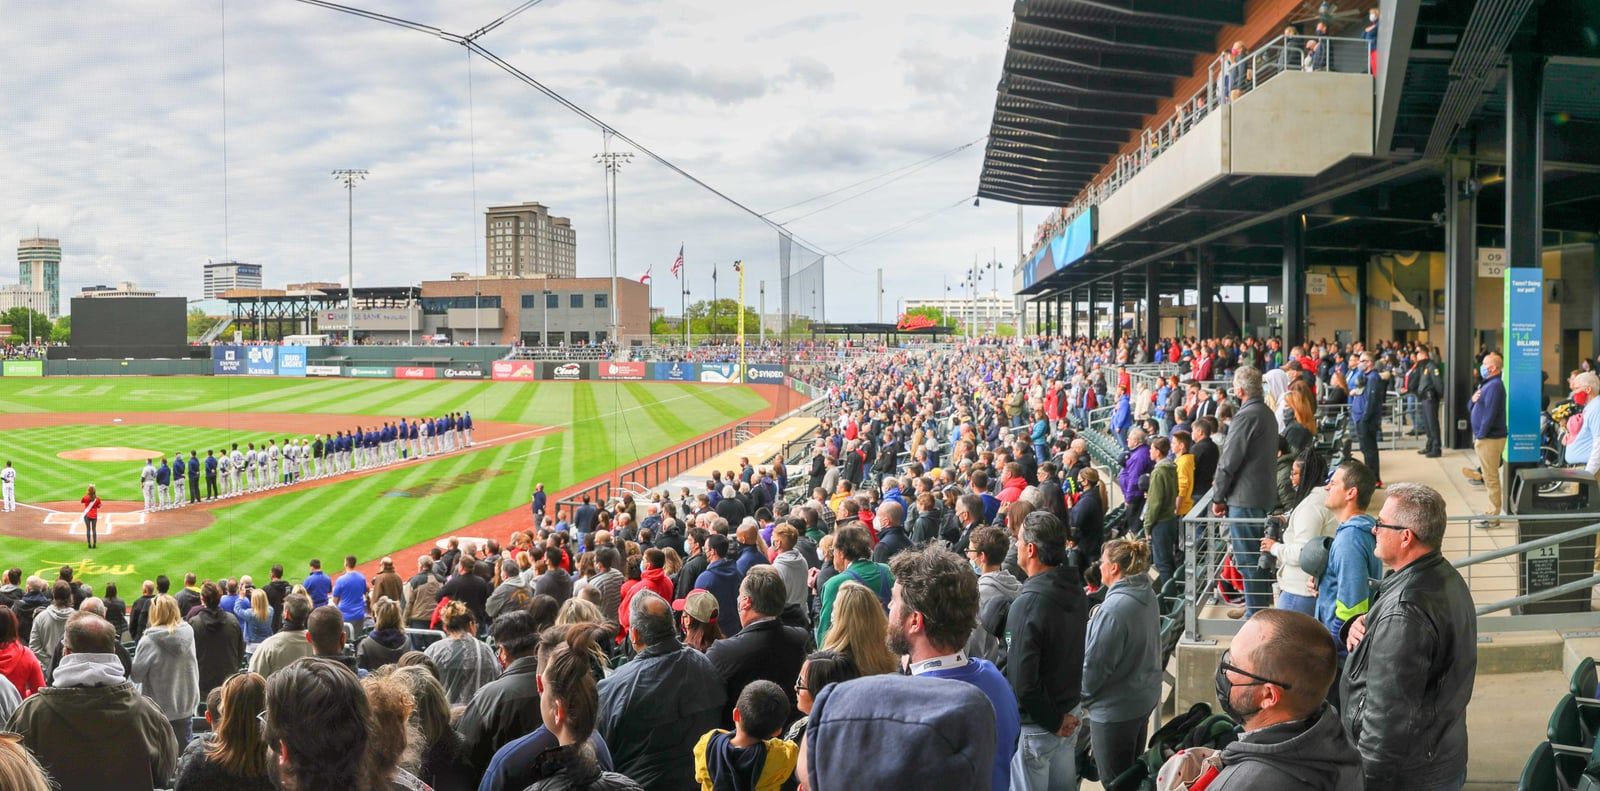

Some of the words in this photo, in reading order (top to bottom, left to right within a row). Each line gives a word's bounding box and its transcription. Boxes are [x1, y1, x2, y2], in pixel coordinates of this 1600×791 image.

[1265, 305, 1279, 315] TEAM
[281, 360, 303, 368] LIGHT
[758, 370, 783, 378] SYNDEO
[1540, 548, 1555, 557] 11
